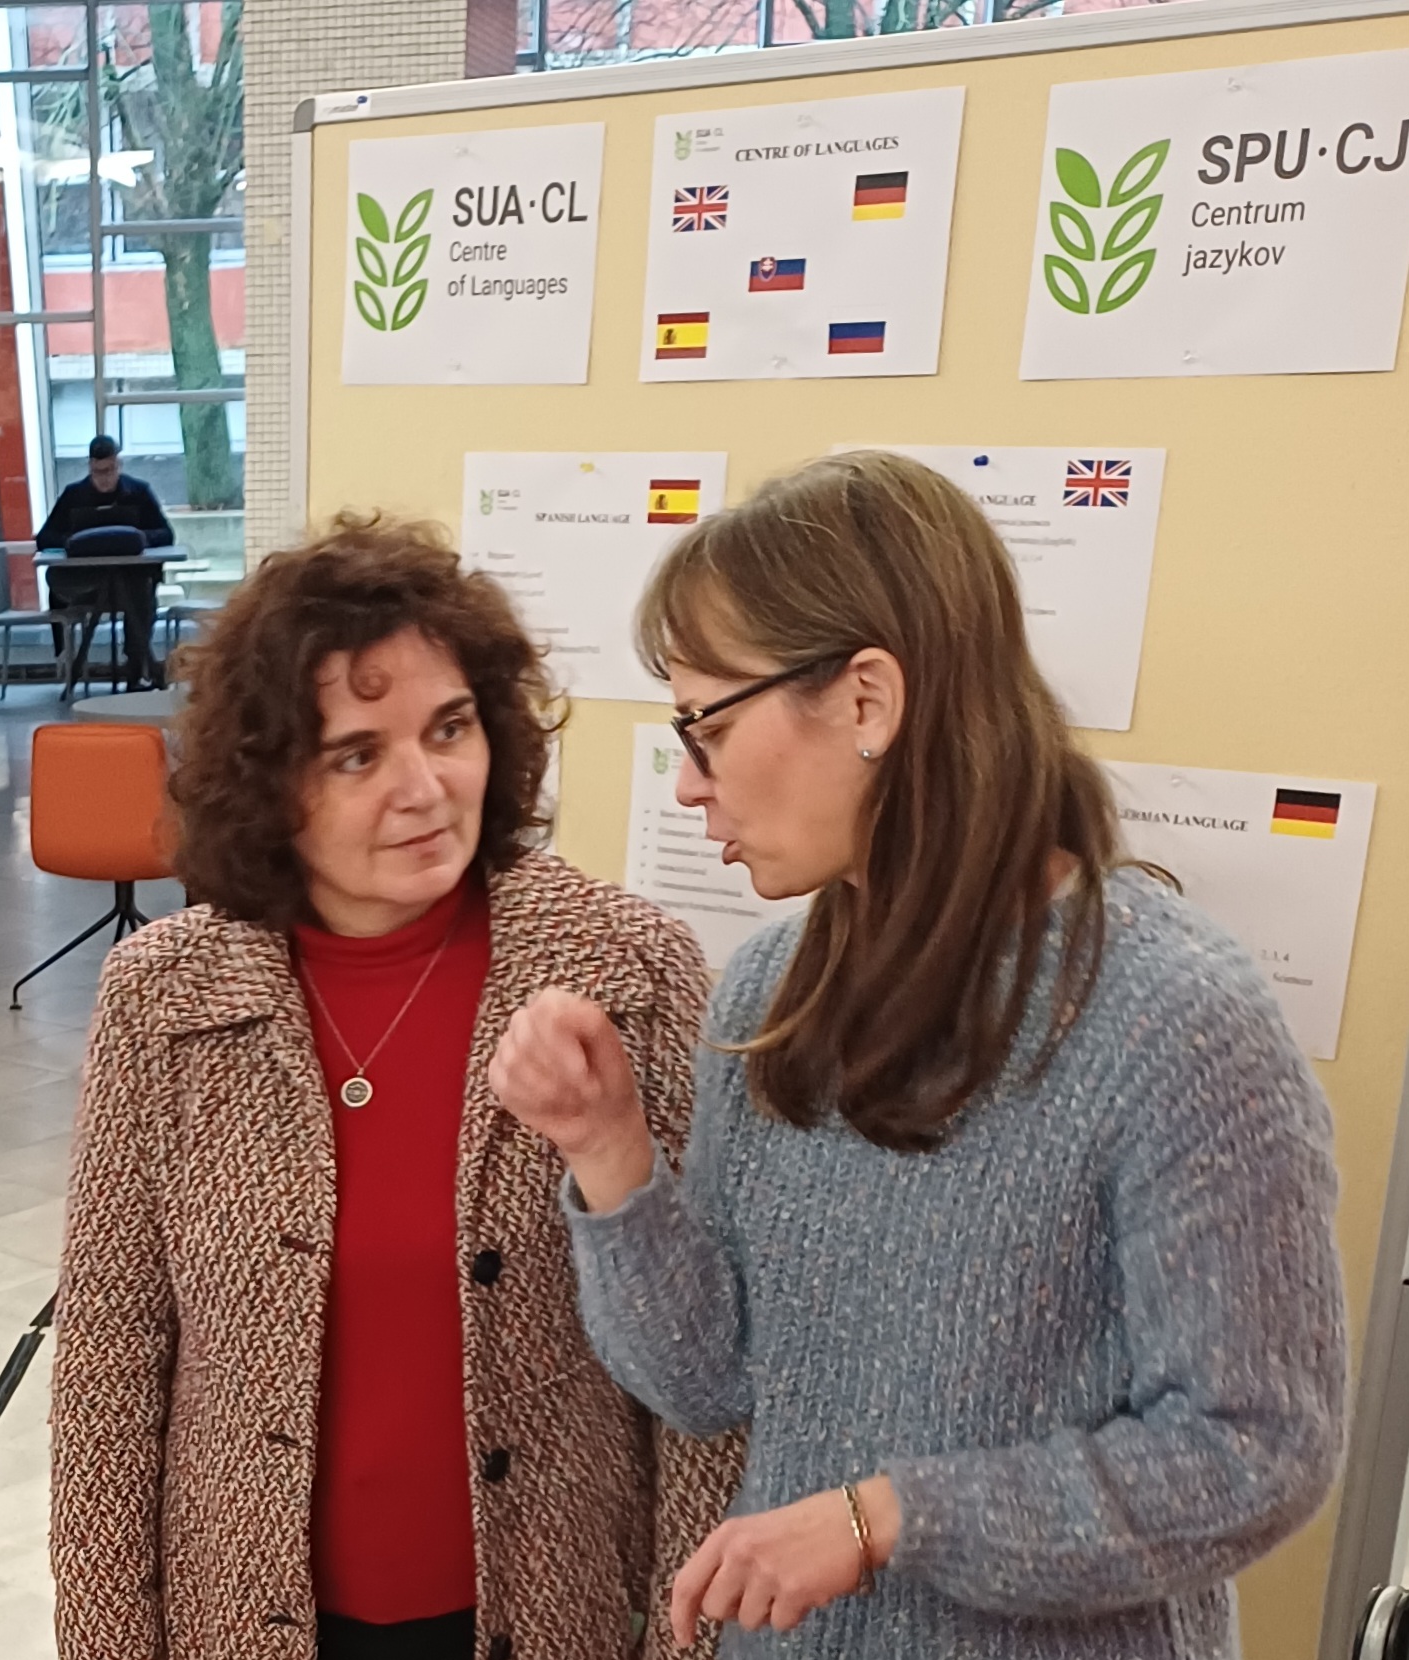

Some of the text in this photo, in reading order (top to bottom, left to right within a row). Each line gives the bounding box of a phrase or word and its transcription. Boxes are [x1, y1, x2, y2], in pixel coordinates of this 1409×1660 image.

[735, 145, 791, 162] CENTRE
[793, 143, 813, 157] OF
[815, 136, 899, 156] LANGUAGES
[1191, 201, 1305, 227] Centrum
[448, 240, 508, 262] Centre
[1182, 240, 1286, 277] jazykov
[447, 274, 569, 301] of Languages
[976, 494, 1037, 507] ANGUAGE
[535, 512, 630, 524] SPANISH LANGUAGE
[1172, 812, 1249, 832] LANGUAGE
